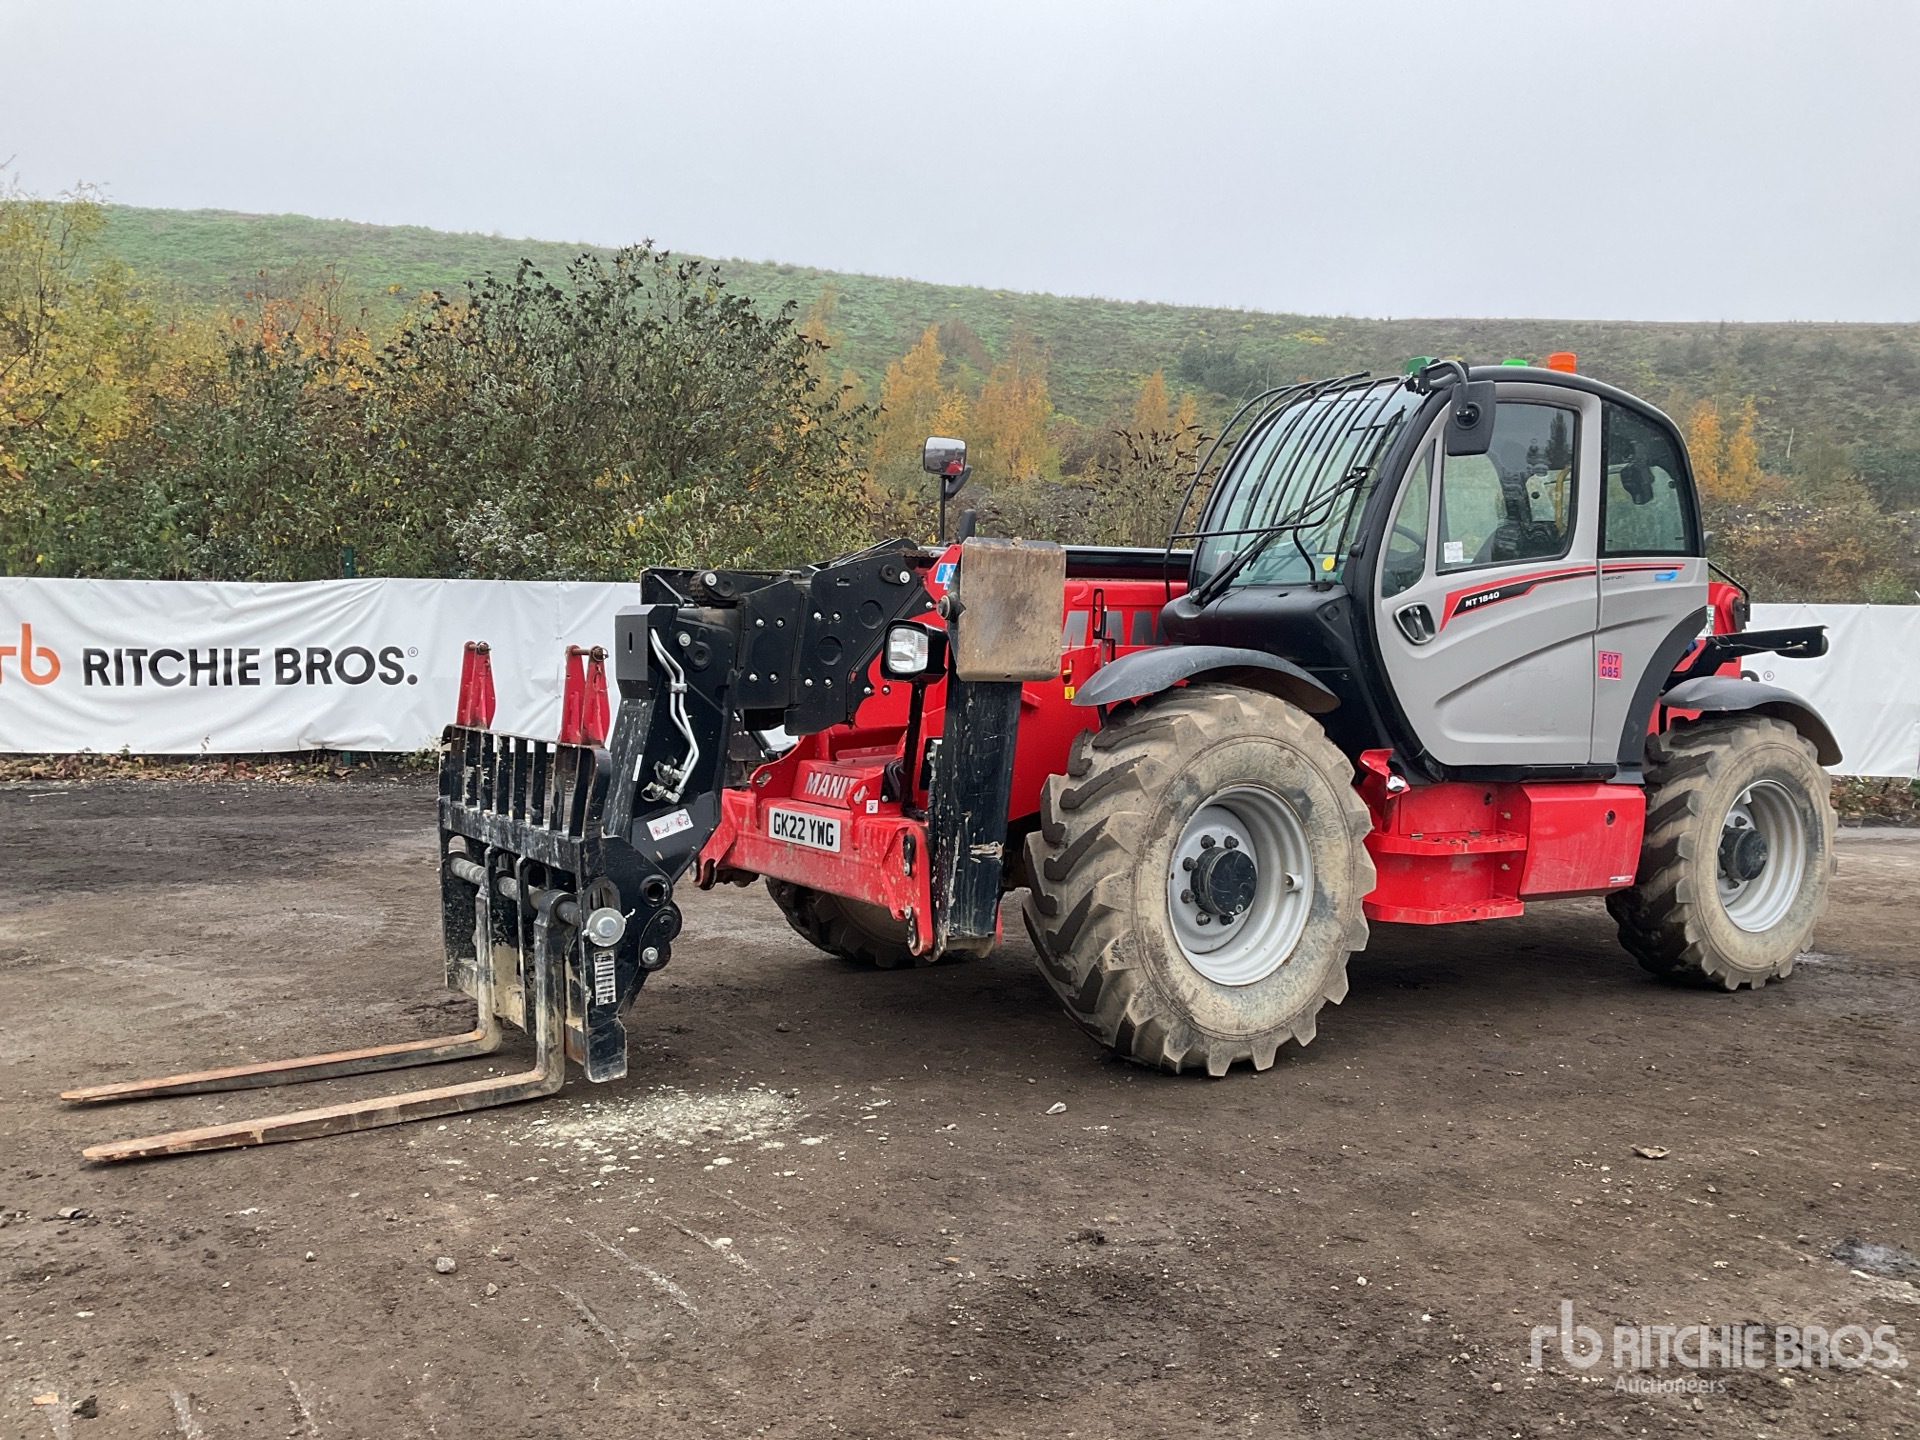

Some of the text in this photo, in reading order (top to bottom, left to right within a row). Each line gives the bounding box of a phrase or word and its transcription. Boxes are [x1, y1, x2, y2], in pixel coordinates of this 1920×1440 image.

[1479, 591, 1500, 603] 1840
[1602, 654, 1619, 665] F07
[83, 647, 260, 687] RITCHIE
[1602, 666, 1619, 678] 085
[773, 812, 834, 847] GK22 YWG
